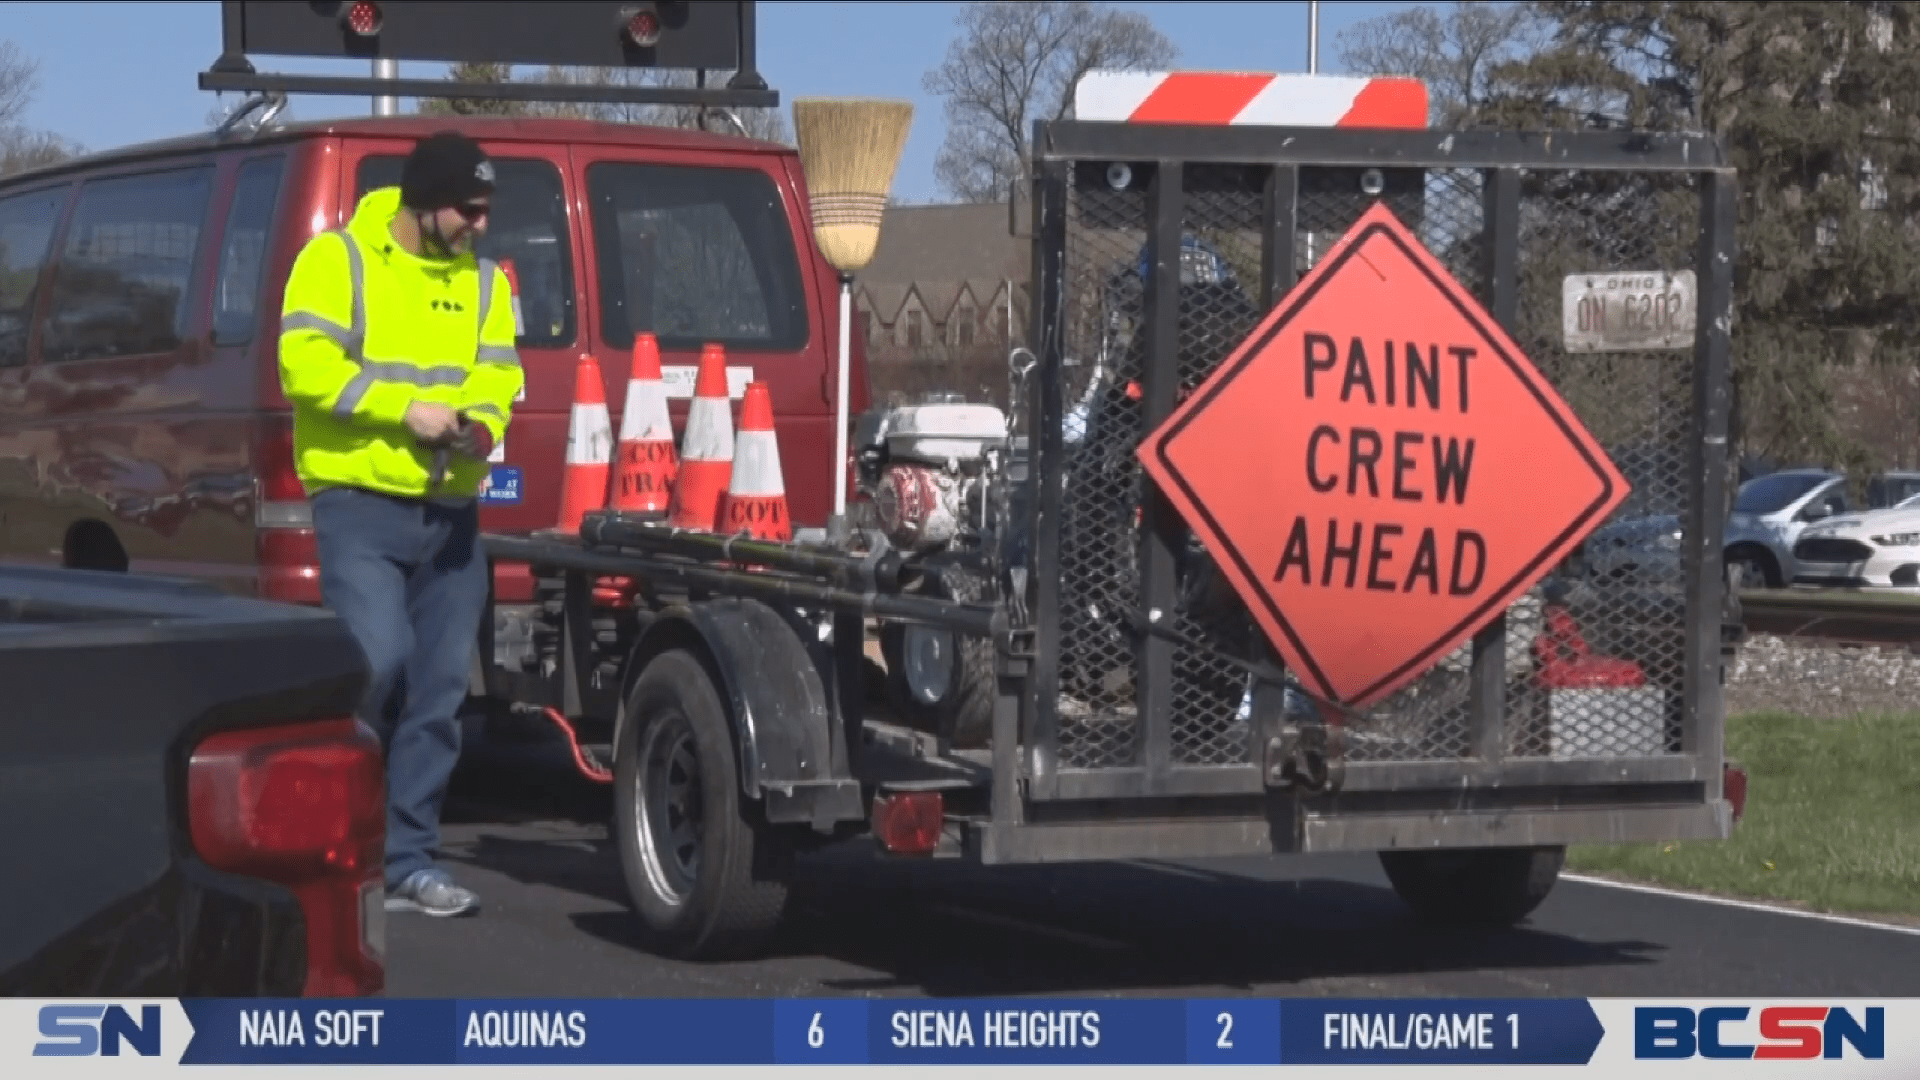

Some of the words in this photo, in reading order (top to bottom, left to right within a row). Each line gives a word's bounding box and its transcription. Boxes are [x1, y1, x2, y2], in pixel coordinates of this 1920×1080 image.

[1607, 277, 1655, 290] OHIO
[1303, 331, 1477, 413] PAINT
[1305, 424, 1475, 505] CREW
[730, 501, 784, 524] COT
[1273, 515, 1487, 596] AHEAD
